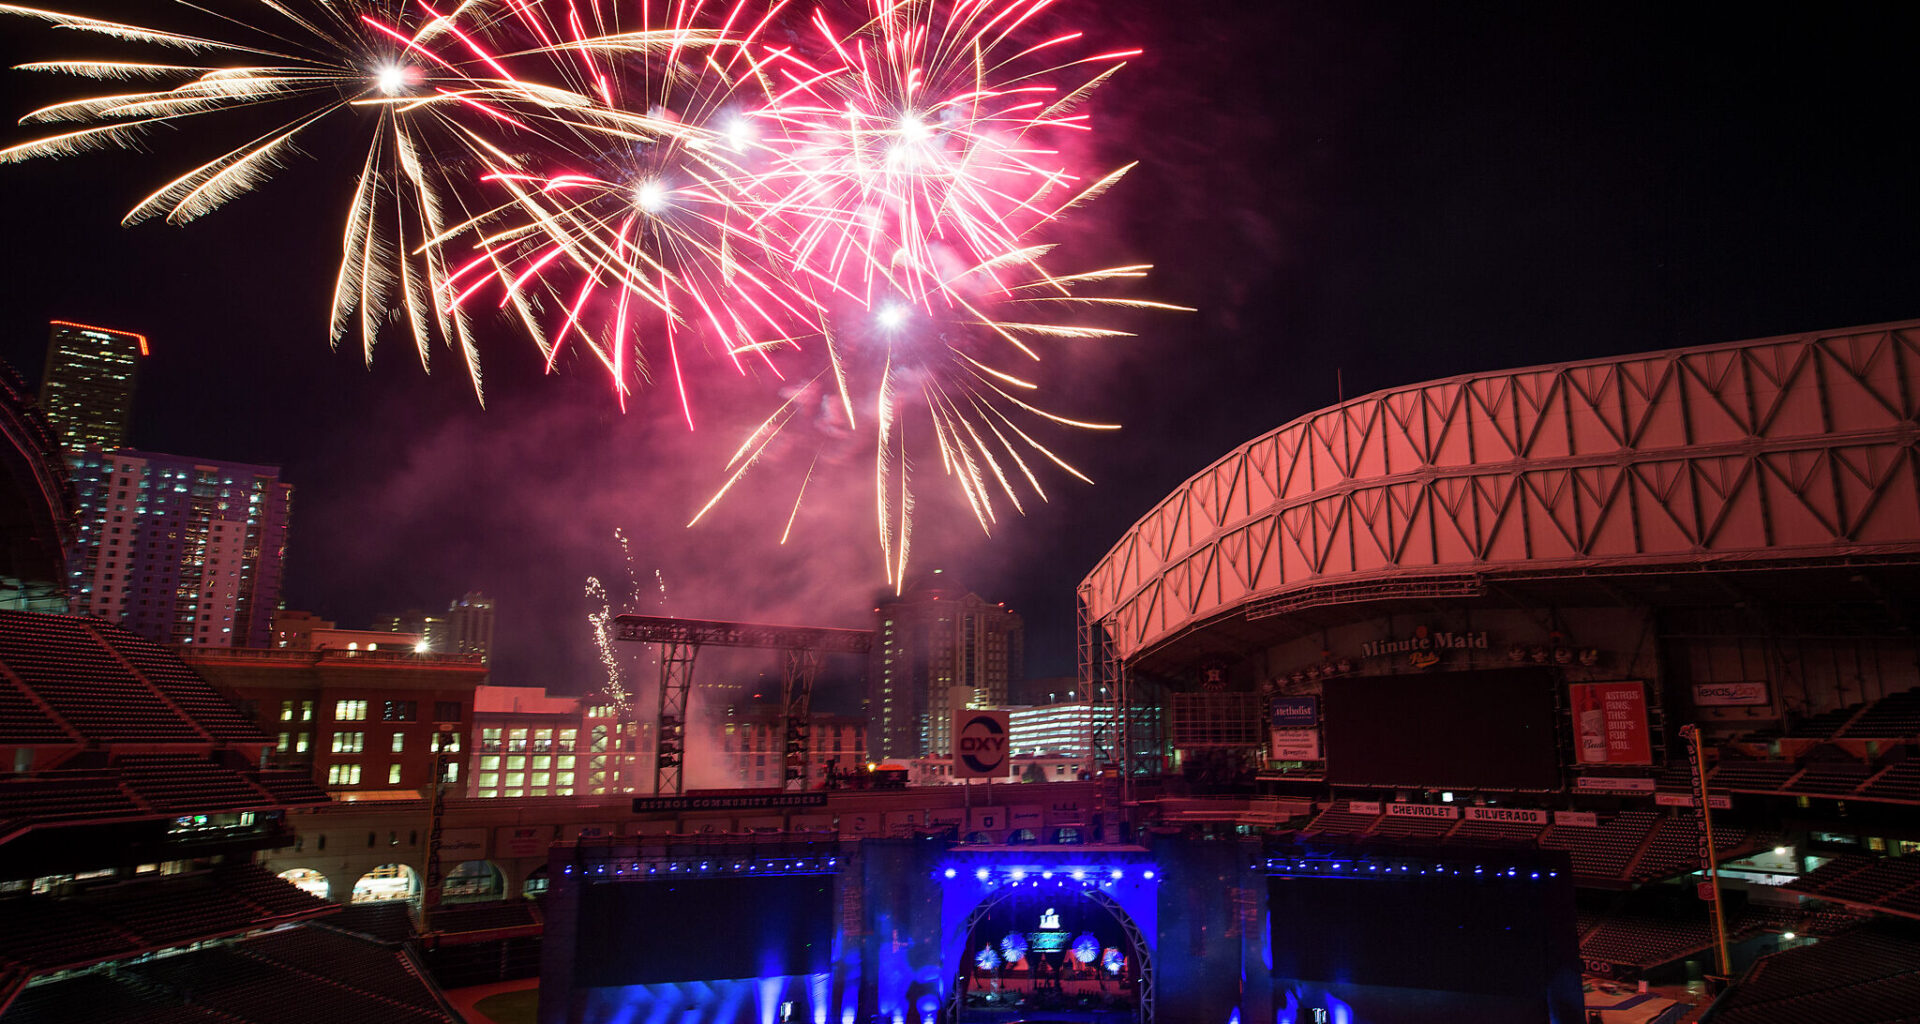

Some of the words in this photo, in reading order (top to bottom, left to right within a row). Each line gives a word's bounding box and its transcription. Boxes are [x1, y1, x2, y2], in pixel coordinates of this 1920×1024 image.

[1360, 637, 1431, 658] Minute
[1433, 631, 1488, 648] Maid
[1605, 690, 1639, 700] ASTROS
[1609, 731, 1626, 740] FOR
[961, 737, 1005, 751] OXY
[640, 799, 688, 810] ASTROS
[692, 797, 768, 809] COMMUNITY
[1392, 805, 1451, 817] CHEVROLET
[1474, 809, 1537, 822] SILVERADO
